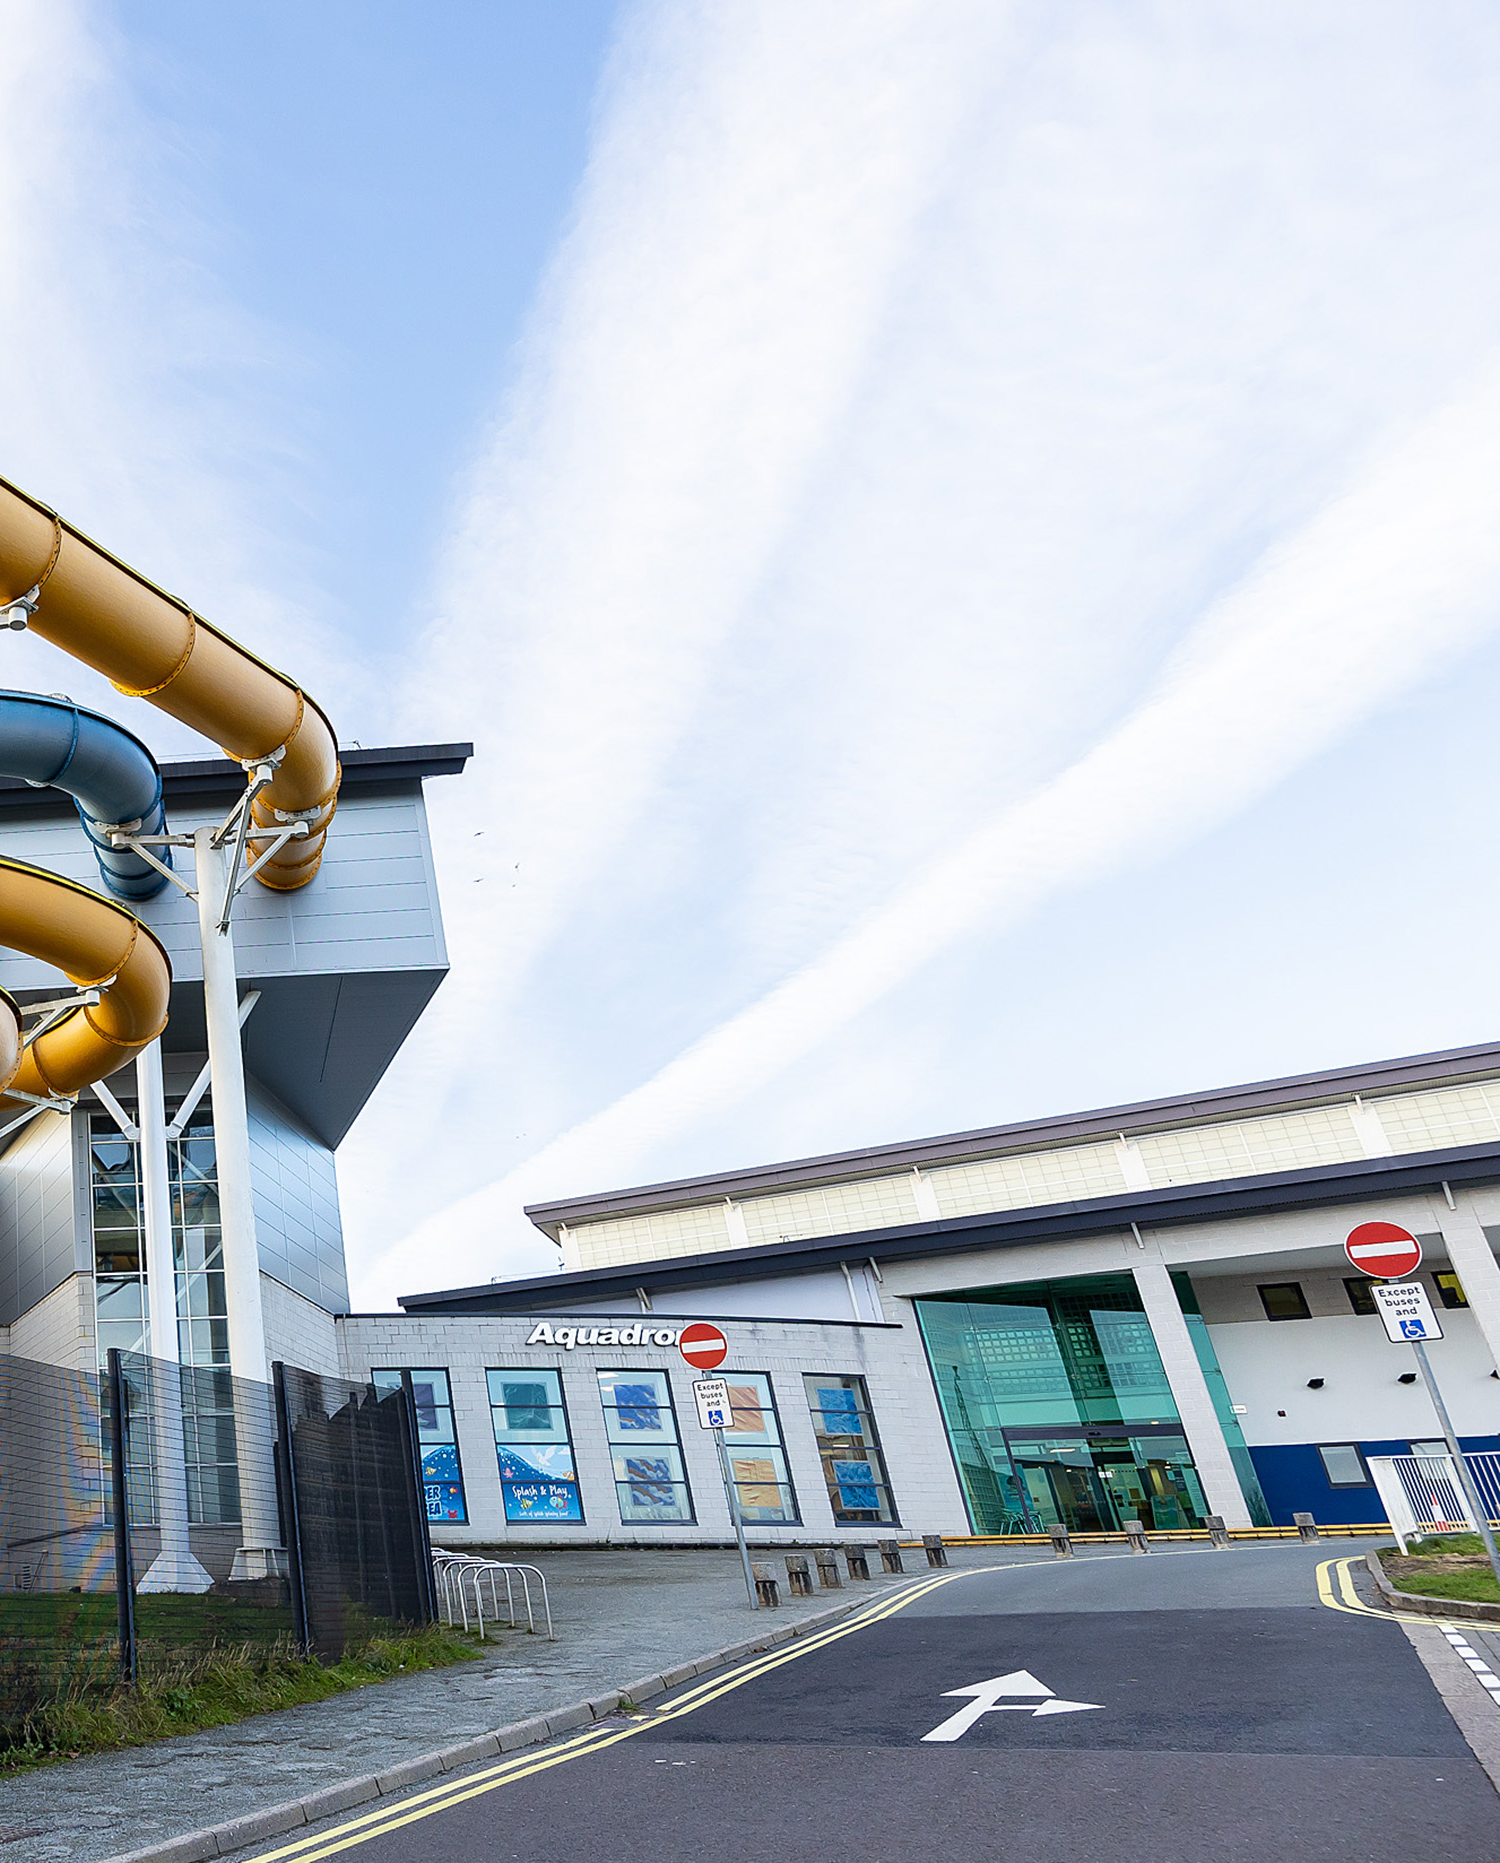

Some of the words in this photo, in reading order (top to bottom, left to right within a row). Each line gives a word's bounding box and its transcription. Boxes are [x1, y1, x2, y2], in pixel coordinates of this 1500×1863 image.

[1377, 1286, 1421, 1297] Except
[1384, 1298, 1421, 1307] buses
[1395, 1307, 1418, 1316] and
[526, 1322, 727, 1350] Aquadro
[697, 1383, 724, 1391] Except
[424, 1485, 441, 1500] ER
[512, 1485, 538, 1500] Splash
[540, 1485, 547, 1496] &
[549, 1485, 568, 1499] Play
[426, 1501, 442, 1516] EA
